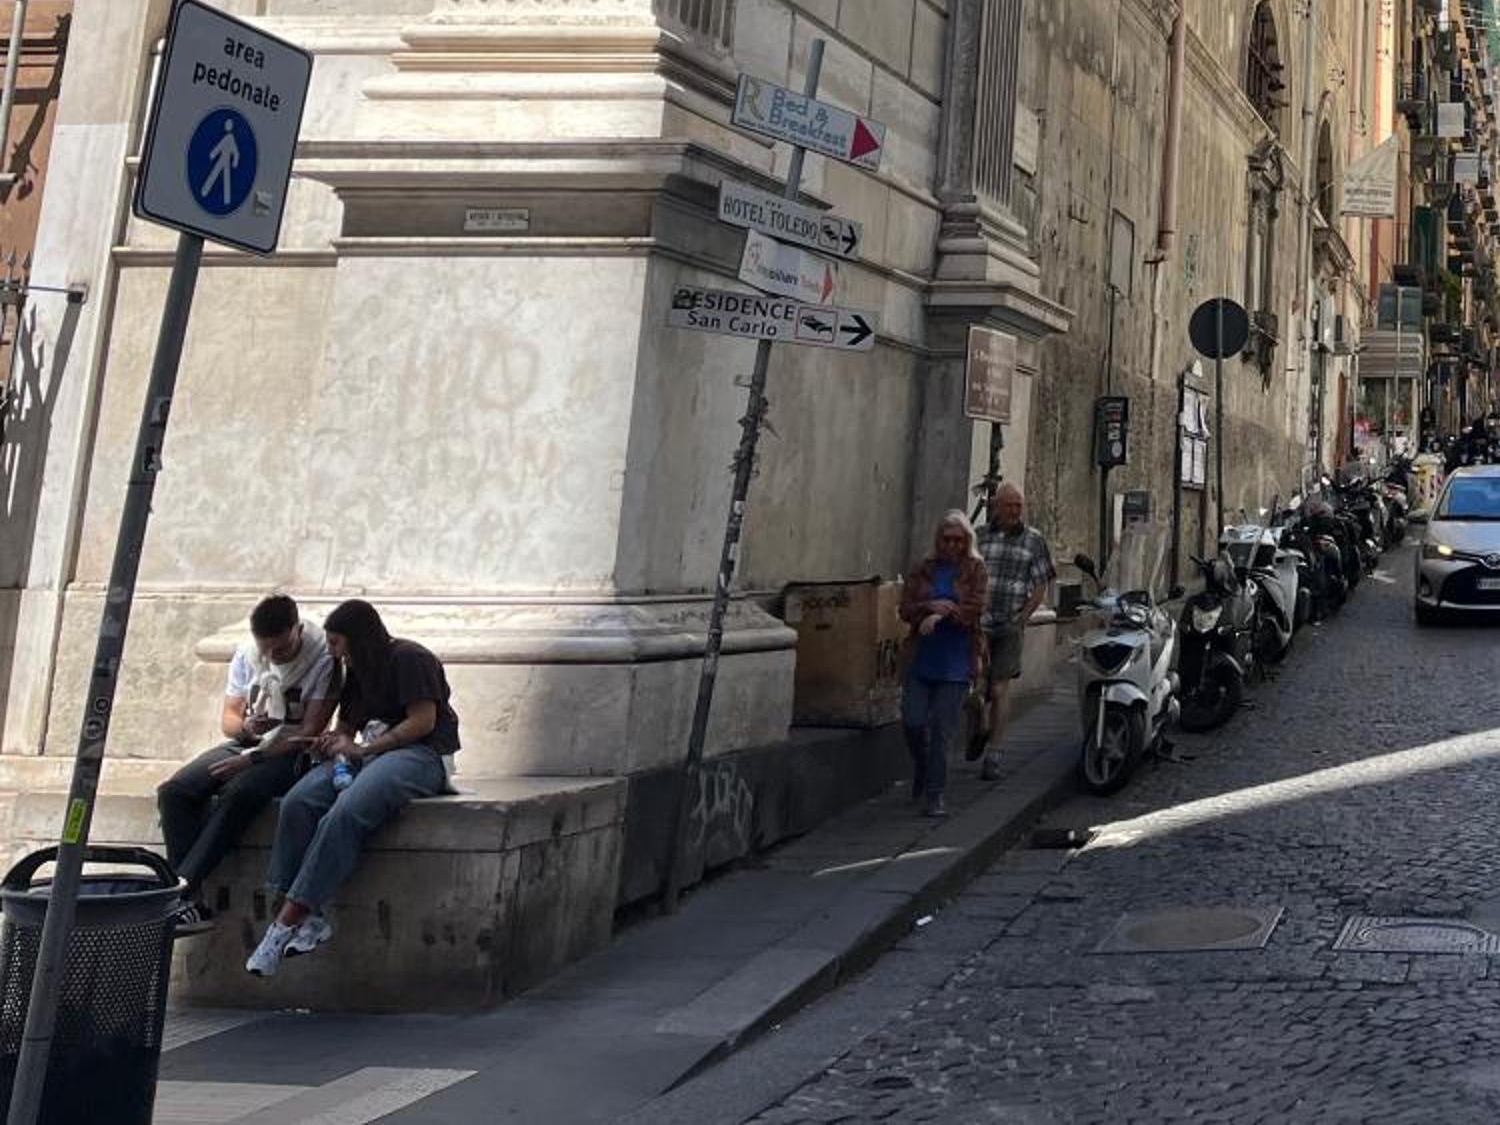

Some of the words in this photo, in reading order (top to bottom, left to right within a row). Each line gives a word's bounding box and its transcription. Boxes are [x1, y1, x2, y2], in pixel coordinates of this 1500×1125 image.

[223, 36, 265, 69] area
[192, 60, 281, 112] pedonale
[773, 88, 809, 116] Bed
[768, 105, 847, 149] Breakfast
[723, 196, 766, 225] HOTEL
[769, 209, 819, 241] TOLEDO
[687, 309, 721, 331] San
[729, 315, 777, 337] Carlo
